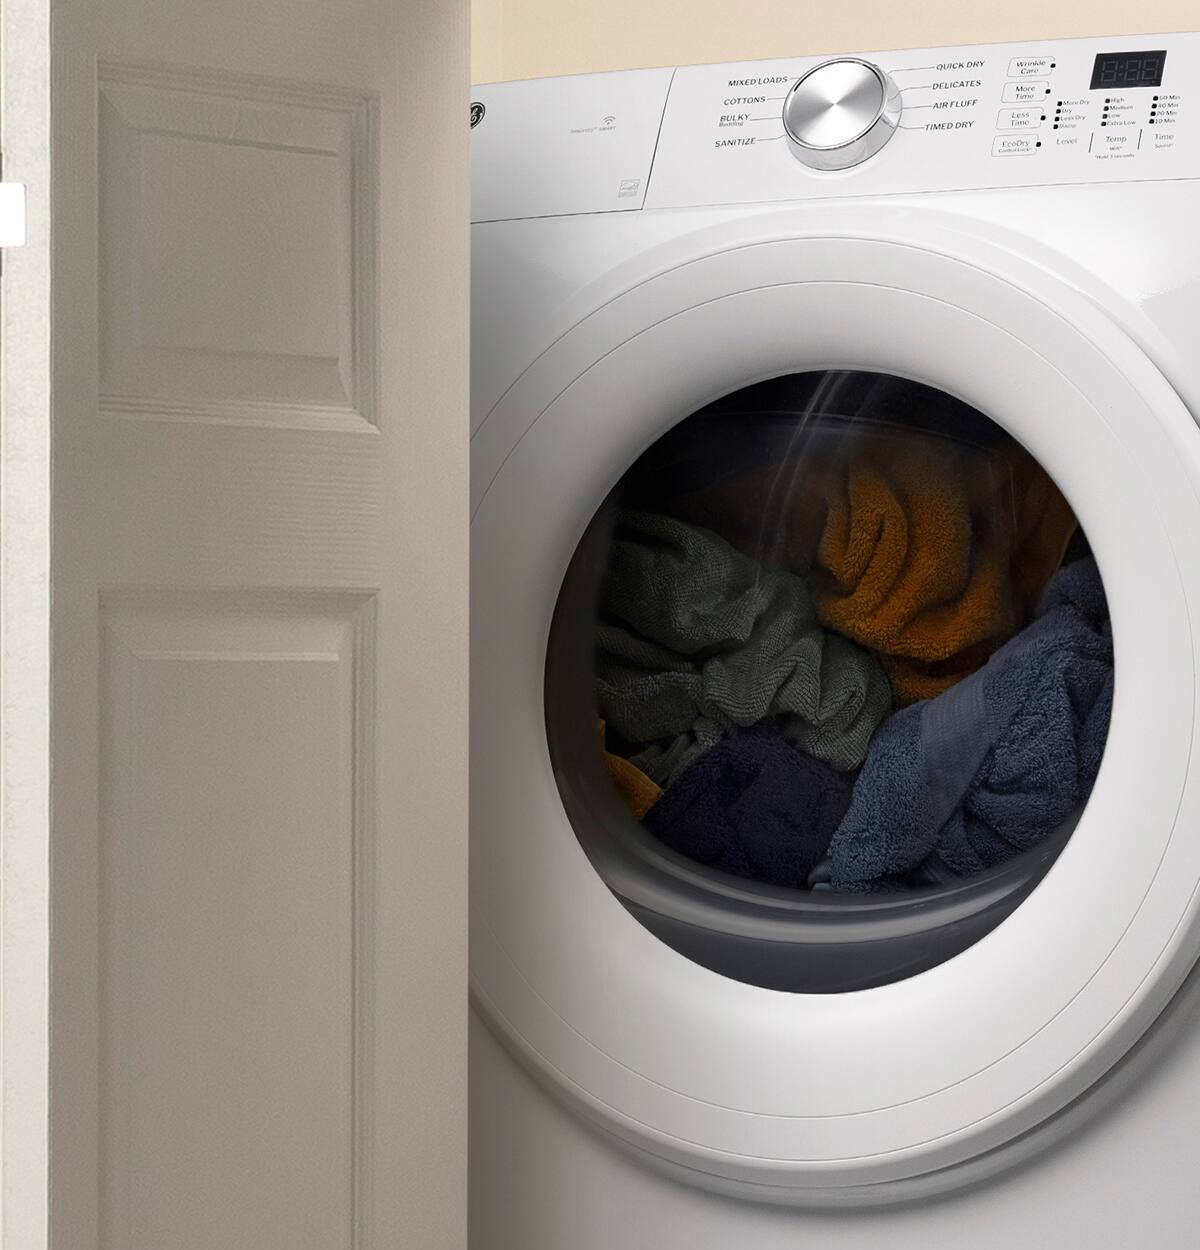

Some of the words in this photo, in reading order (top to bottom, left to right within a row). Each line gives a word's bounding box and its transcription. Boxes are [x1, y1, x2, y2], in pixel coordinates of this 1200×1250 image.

[936, 62, 964, 71] QUICK
[966, 60, 985, 68] DRY
[728, 79, 757, 87] MIXED
[758, 76, 788, 85] LOADS
[932, 80, 981, 90] DELICATES
[723, 96, 766, 106] COTTONS
[933, 101, 949, 109] AIR
[950, 99, 978, 108] FLUFF
[720, 113, 750, 122] BULKY
[925, 122, 953, 131] TIMED
[955, 120, 974, 129] DRY
[1010, 119, 1029, 127] Time
[715, 137, 756, 147] SANITIZE
[1105, 135, 1127, 143] Temp
[1154, 133, 1174, 141] Time
